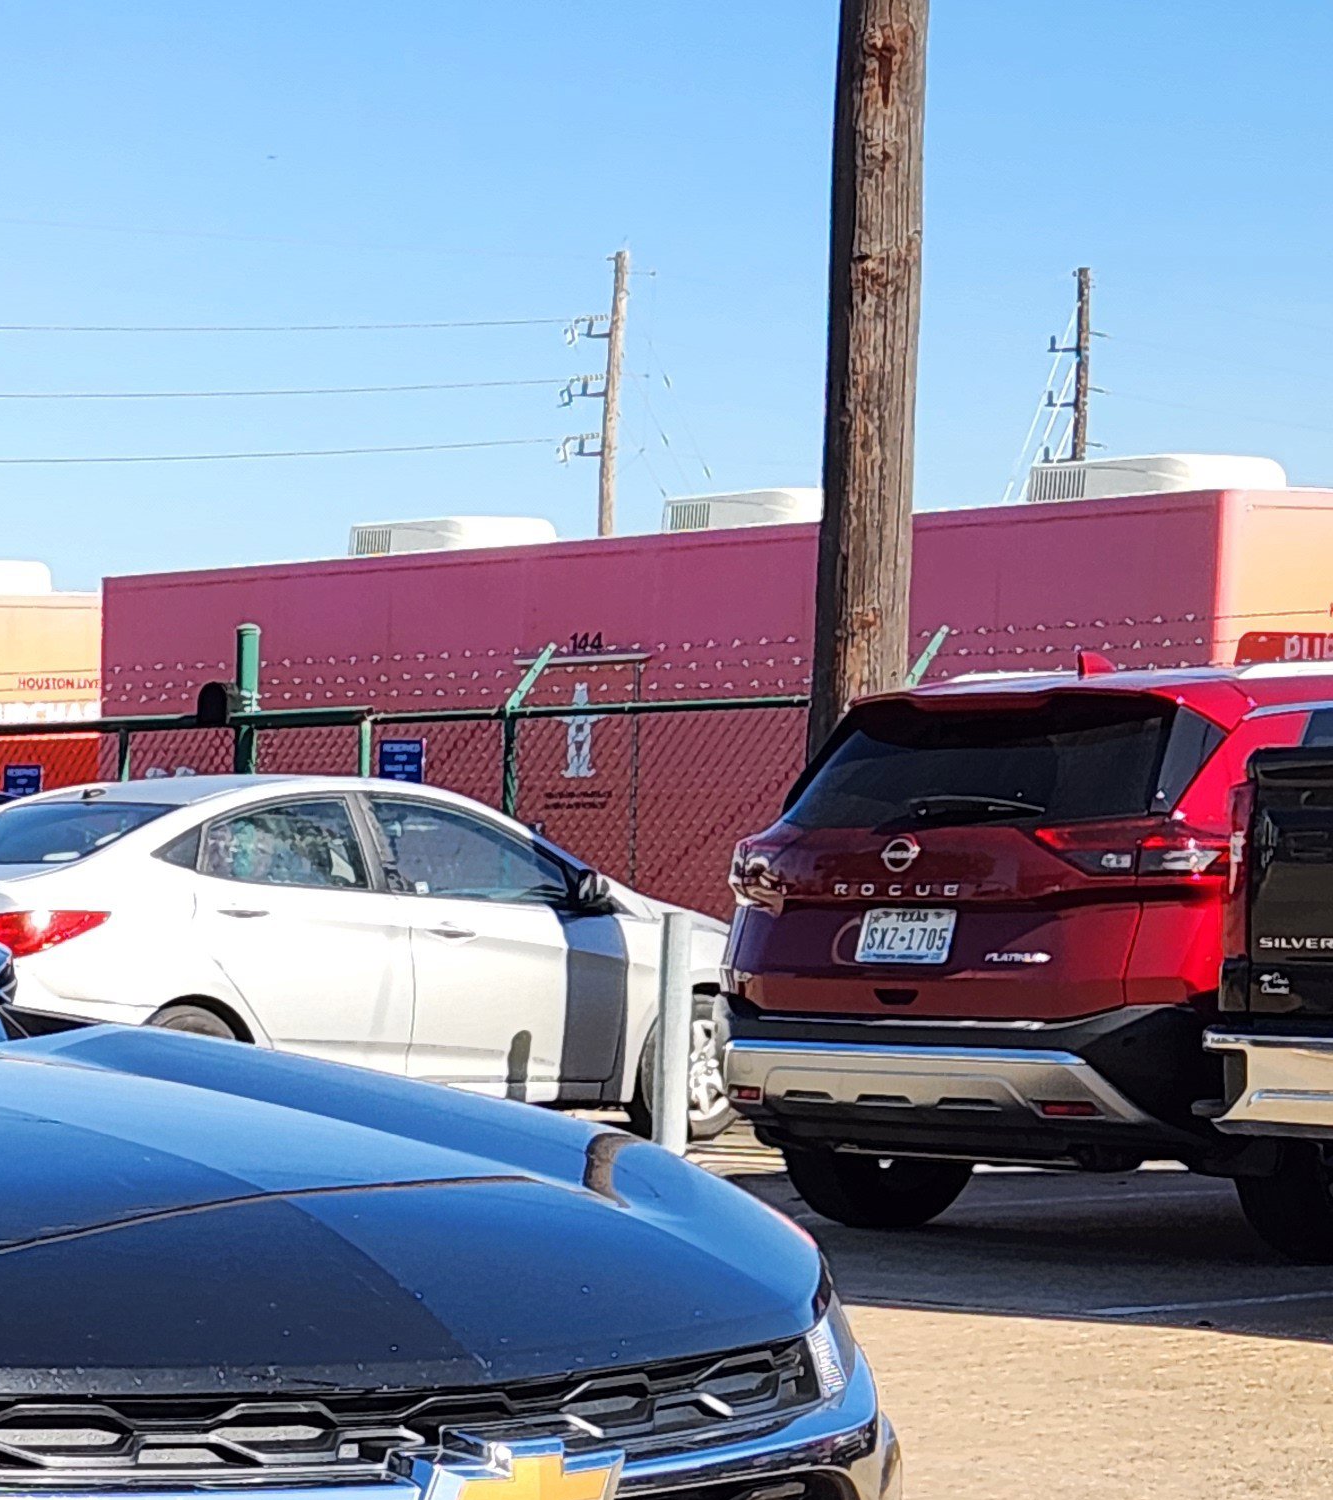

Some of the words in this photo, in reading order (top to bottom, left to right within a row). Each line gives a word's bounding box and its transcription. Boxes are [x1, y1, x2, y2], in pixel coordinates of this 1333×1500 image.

[570, 632, 603, 653] 144
[18, 677, 75, 690] HOUSTON
[895, 910, 929, 922] TEXAS
